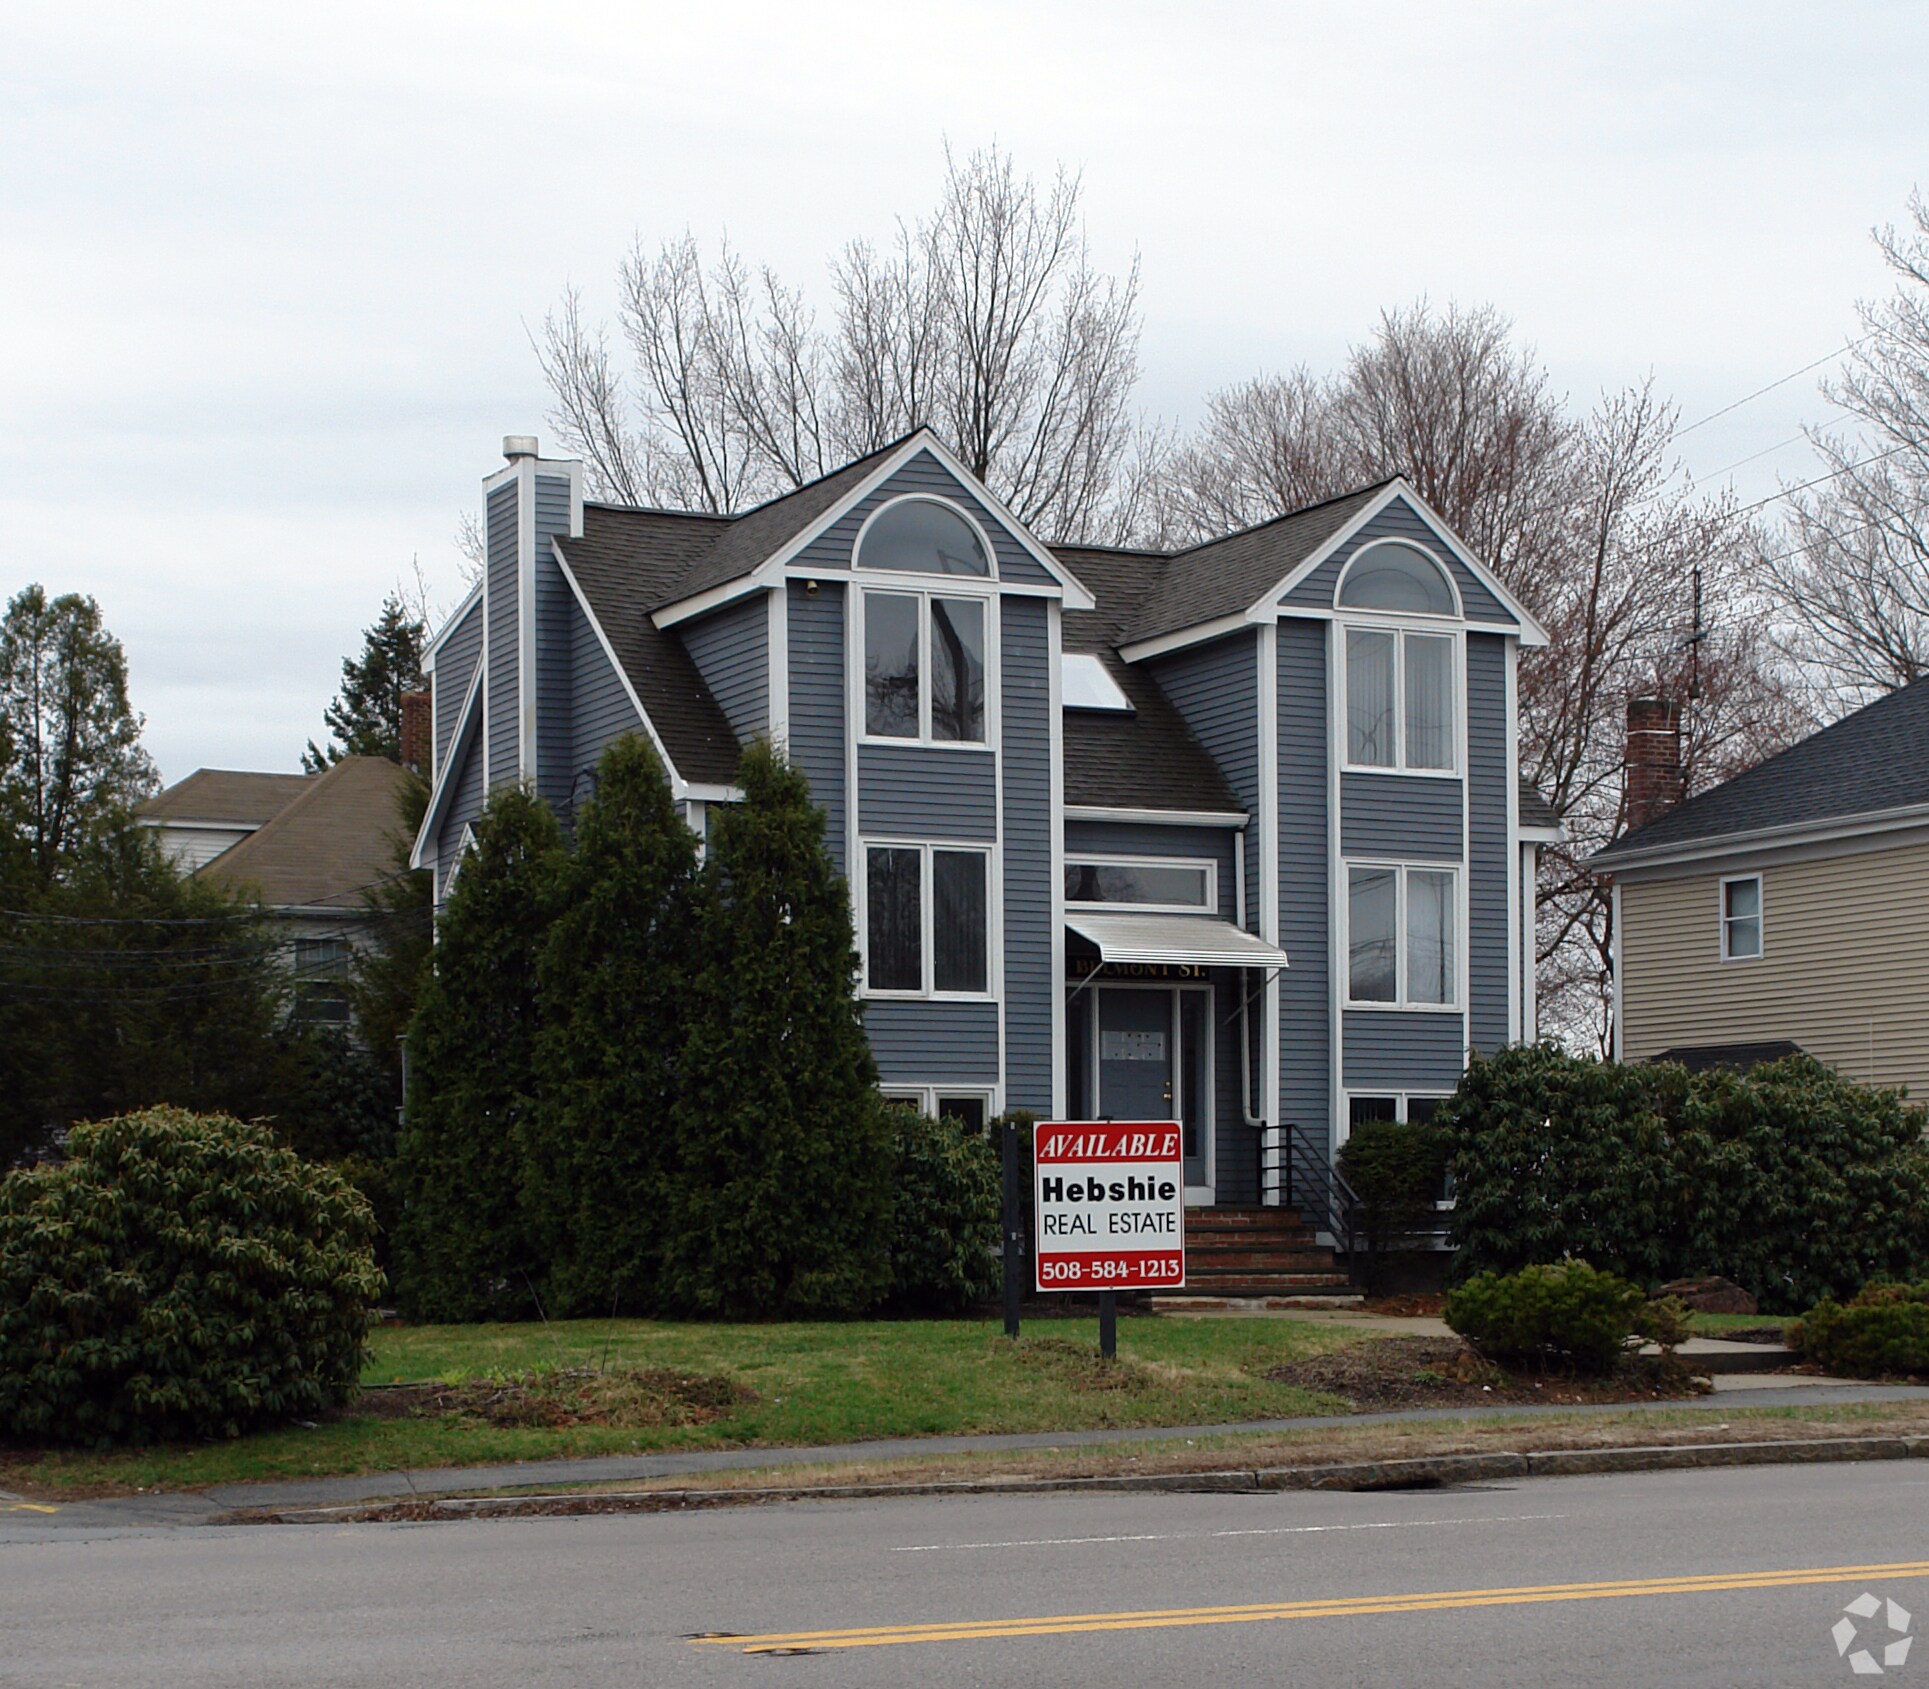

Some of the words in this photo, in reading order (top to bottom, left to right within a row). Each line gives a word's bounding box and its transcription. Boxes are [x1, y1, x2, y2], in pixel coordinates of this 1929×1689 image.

[1039, 1133, 1178, 1158] AVAILABLE
[1042, 1175, 1176, 1202] Hebshie
[1044, 1213, 1097, 1235] REAL
[1109, 1212, 1176, 1234] ESTATE
[1042, 1260, 1180, 1280] 508-584-1213
